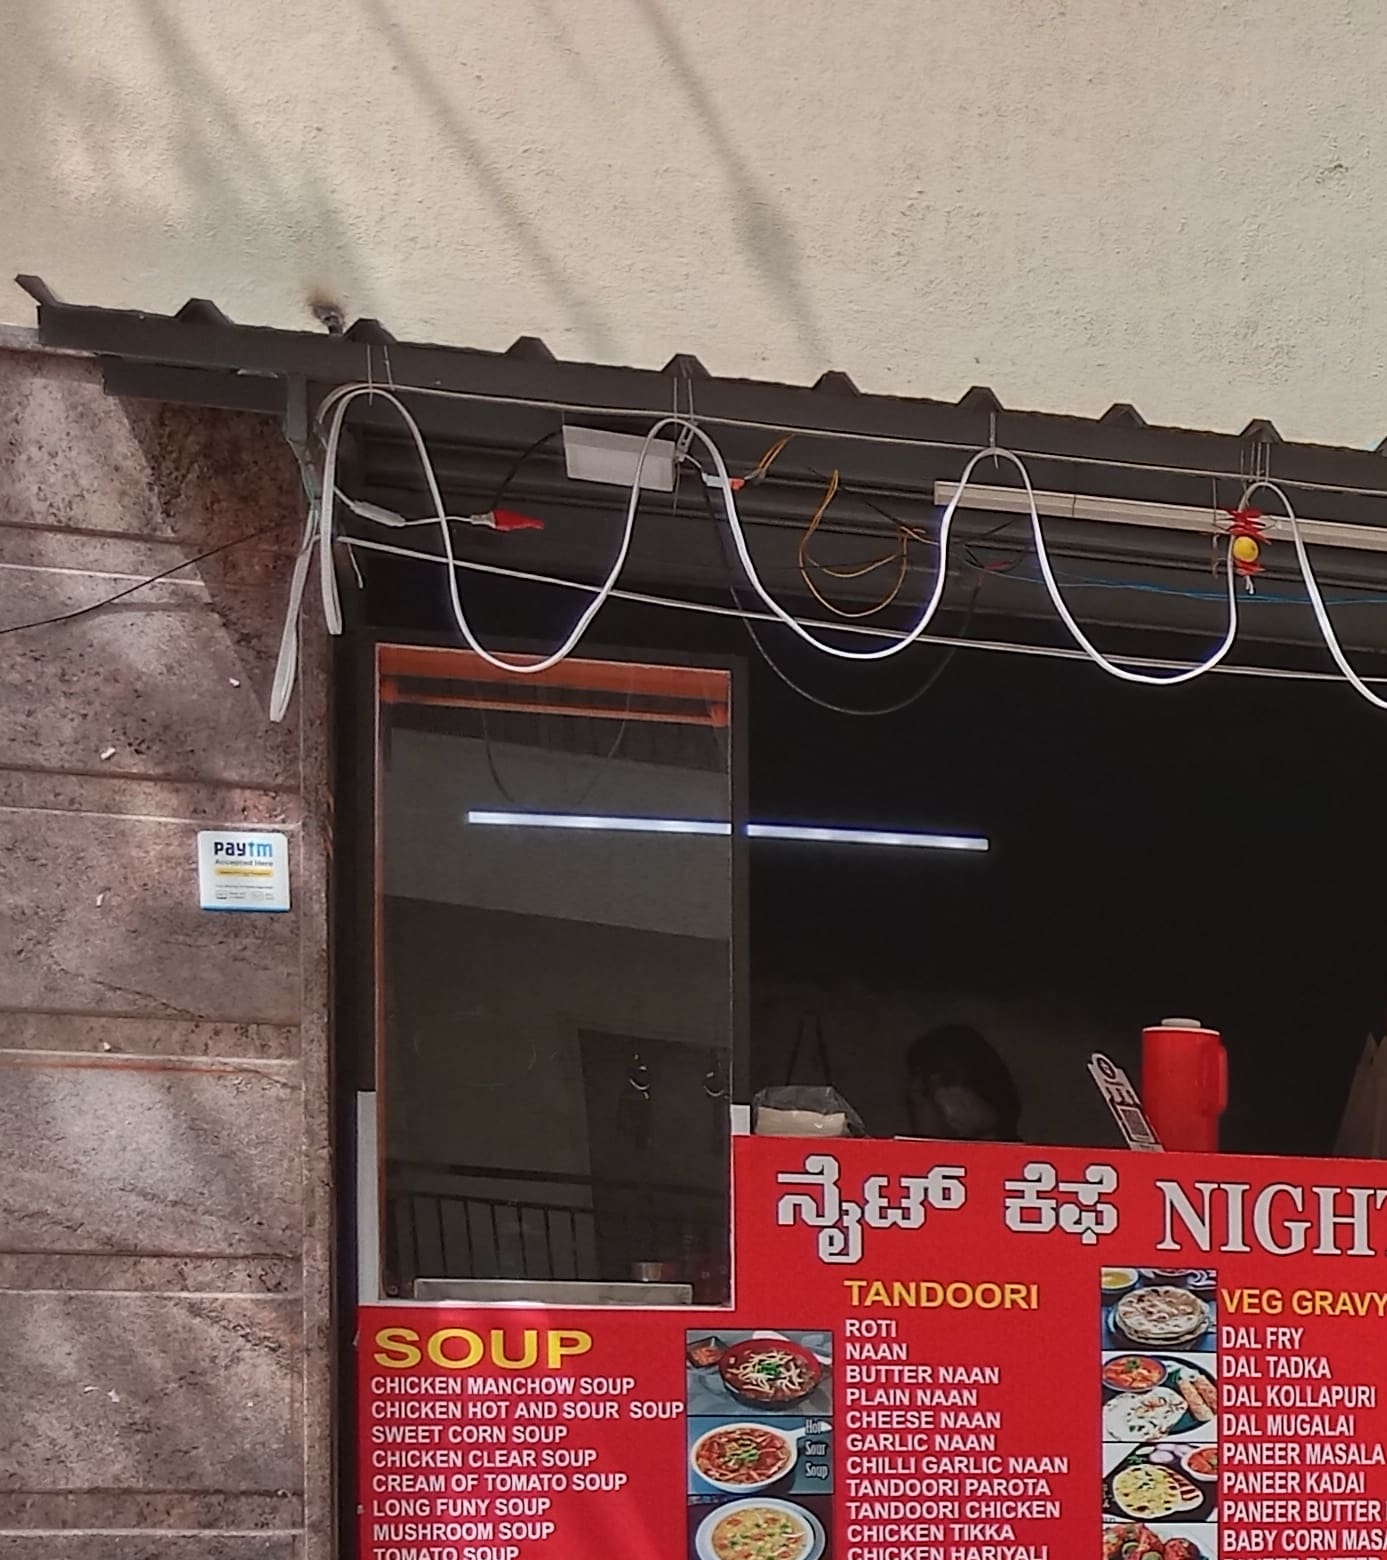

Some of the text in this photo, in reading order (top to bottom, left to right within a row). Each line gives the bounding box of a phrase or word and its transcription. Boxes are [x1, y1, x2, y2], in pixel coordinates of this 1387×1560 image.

[776, 1154, 1119, 1265] ನೈಟ್ ಕೆಫೆ
[843, 1280, 1038, 1309] TANDOORI
[1221, 1288, 1283, 1314] VEG
[845, 1319, 897, 1338] ROTI
[374, 1328, 592, 1369] SOUP
[845, 1342, 907, 1361] NAAN
[845, 1365, 999, 1384] BUTTER NAAN
[1222, 1355, 1332, 1379] DAL TADKA
[371, 1376, 635, 1395] CHICKEN MANCHOW SOUP
[846, 1388, 977, 1406] PLAIN NAAN
[1222, 1384, 1376, 1408] DAL KOLLAPURI
[371, 1401, 684, 1419] CHICKEN HOT AND SOUR SOUP
[846, 1410, 1001, 1429] CHEESE NAAN
[371, 1425, 568, 1444] SWEET CORN SOUP
[1222, 1413, 1354, 1437] DAL MUGALAI
[846, 1433, 995, 1452] GARLIC NAAN
[372, 1449, 597, 1468] CHICKEN CLEAR SOUP
[1222, 1442, 1386, 1465] PANEER MASALA
[804, 1462, 829, 1479] Soup
[846, 1456, 1068, 1474] CHILLI GARLIC NAAN
[372, 1473, 627, 1492] CREAM OF TOMATO SOUP
[845, 1478, 1051, 1497] TANDOORI PAROTA
[373, 1497, 551, 1517] LONG FUNY SOUP
[845, 1500, 1060, 1520] TANDOORI CHICKEN
[1223, 1500, 1301, 1523] PANEER
[1305, 1500, 1382, 1523] BUTTER
[373, 1521, 555, 1541] MUSHROOM SOUP
[847, 1523, 1015, 1543] CHICKEN TIKKA
[1223, 1529, 1278, 1552] BABY
[1281, 1529, 1337, 1552] CORN
